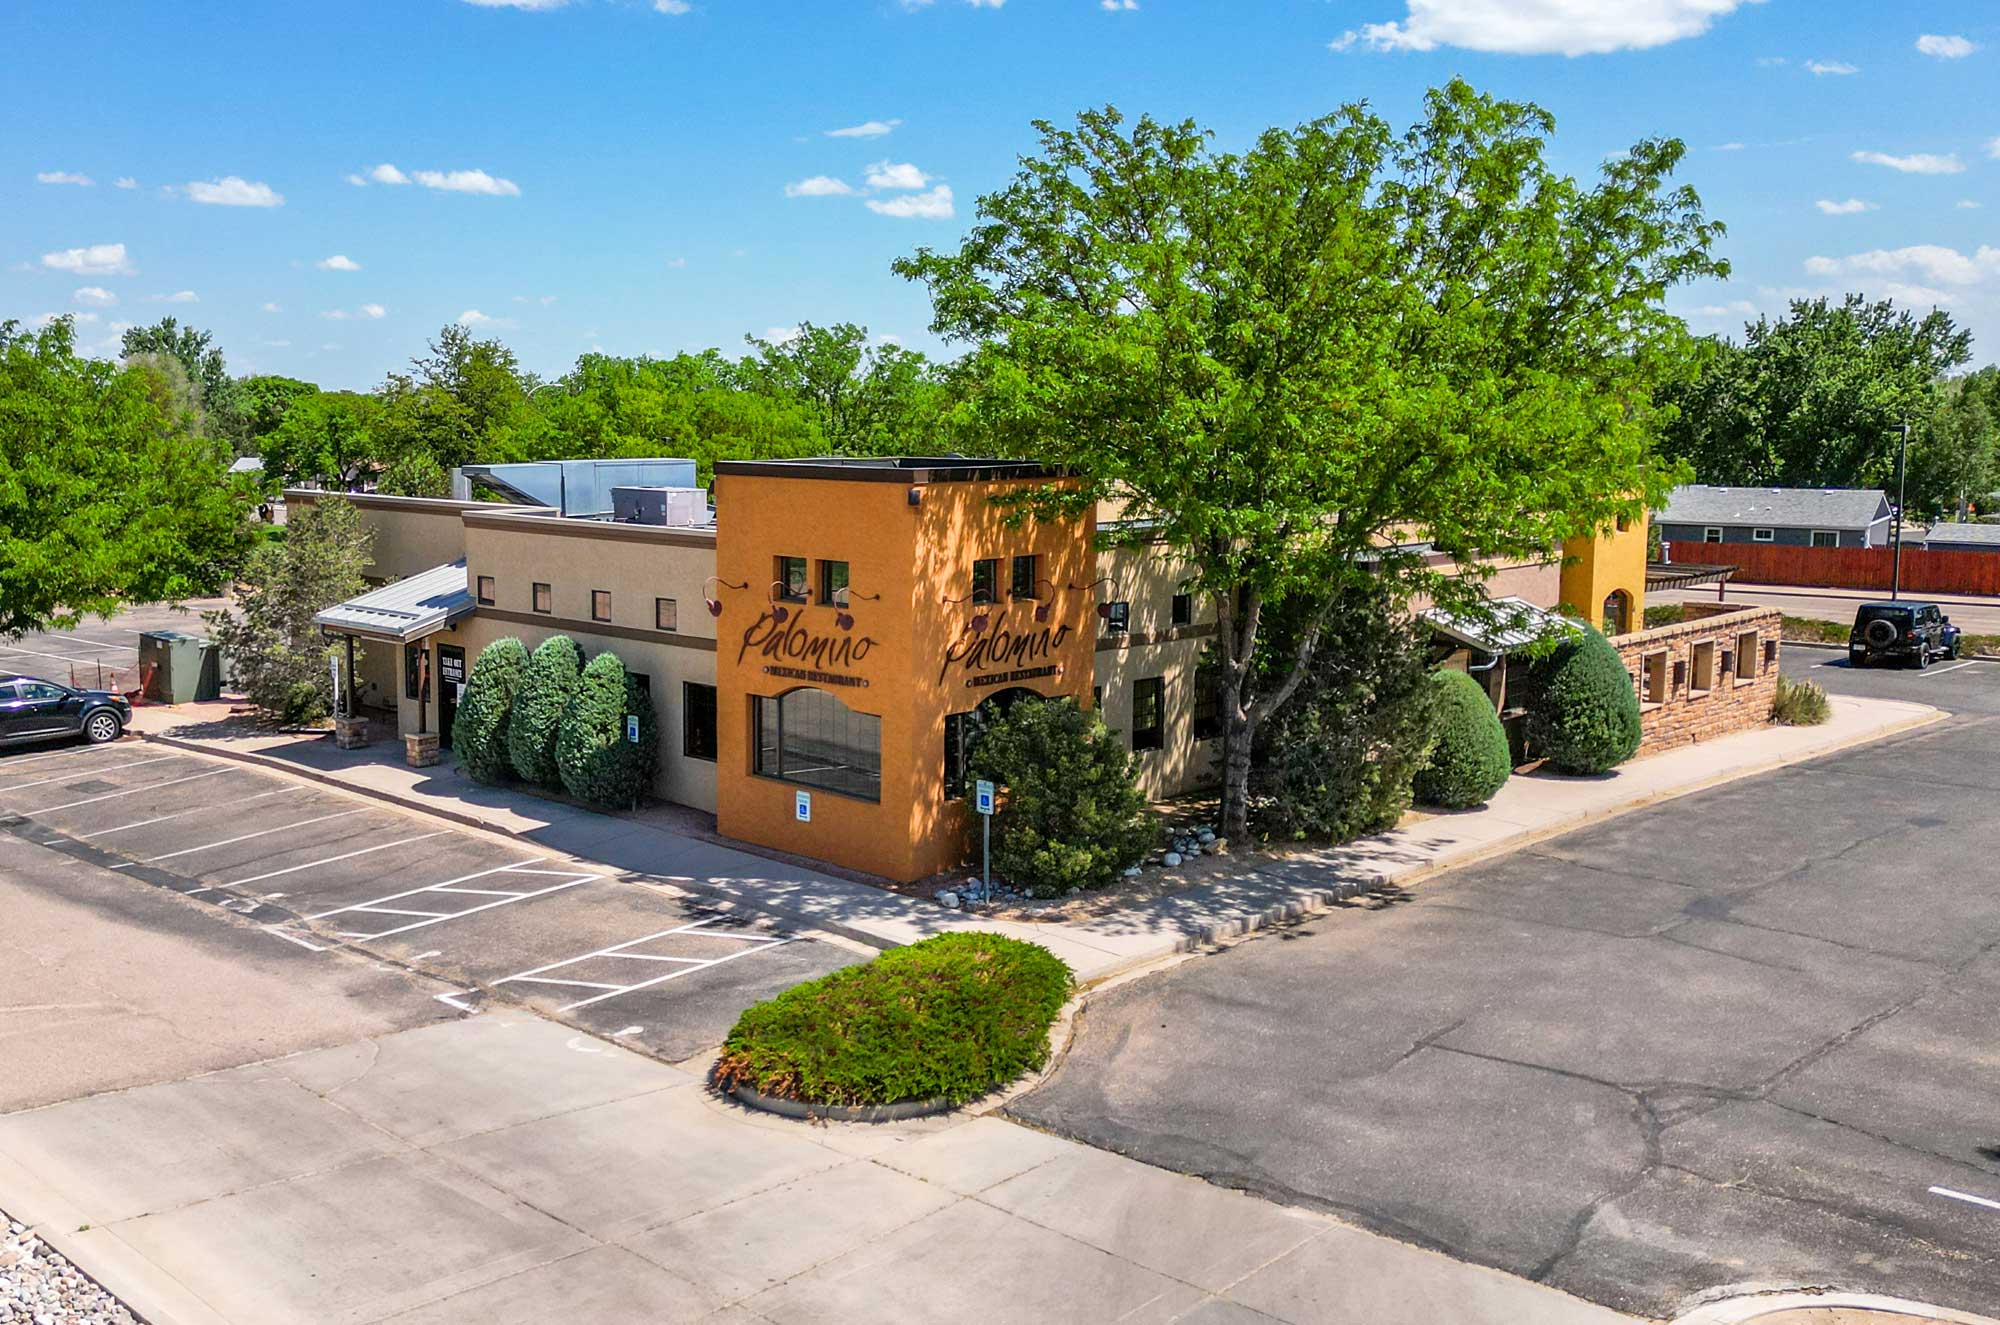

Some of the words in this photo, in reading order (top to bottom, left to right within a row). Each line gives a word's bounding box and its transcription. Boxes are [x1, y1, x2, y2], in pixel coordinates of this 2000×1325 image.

[737, 608, 879, 669] Palomino
[938, 610, 1072, 687] Palomino
[770, 666, 806, 680] MEXICAN
[807, 669, 863, 688] RESTAURANT
[973, 672, 1009, 687] MEXICAN
[1010, 665, 1057, 681] RESTAURANT
